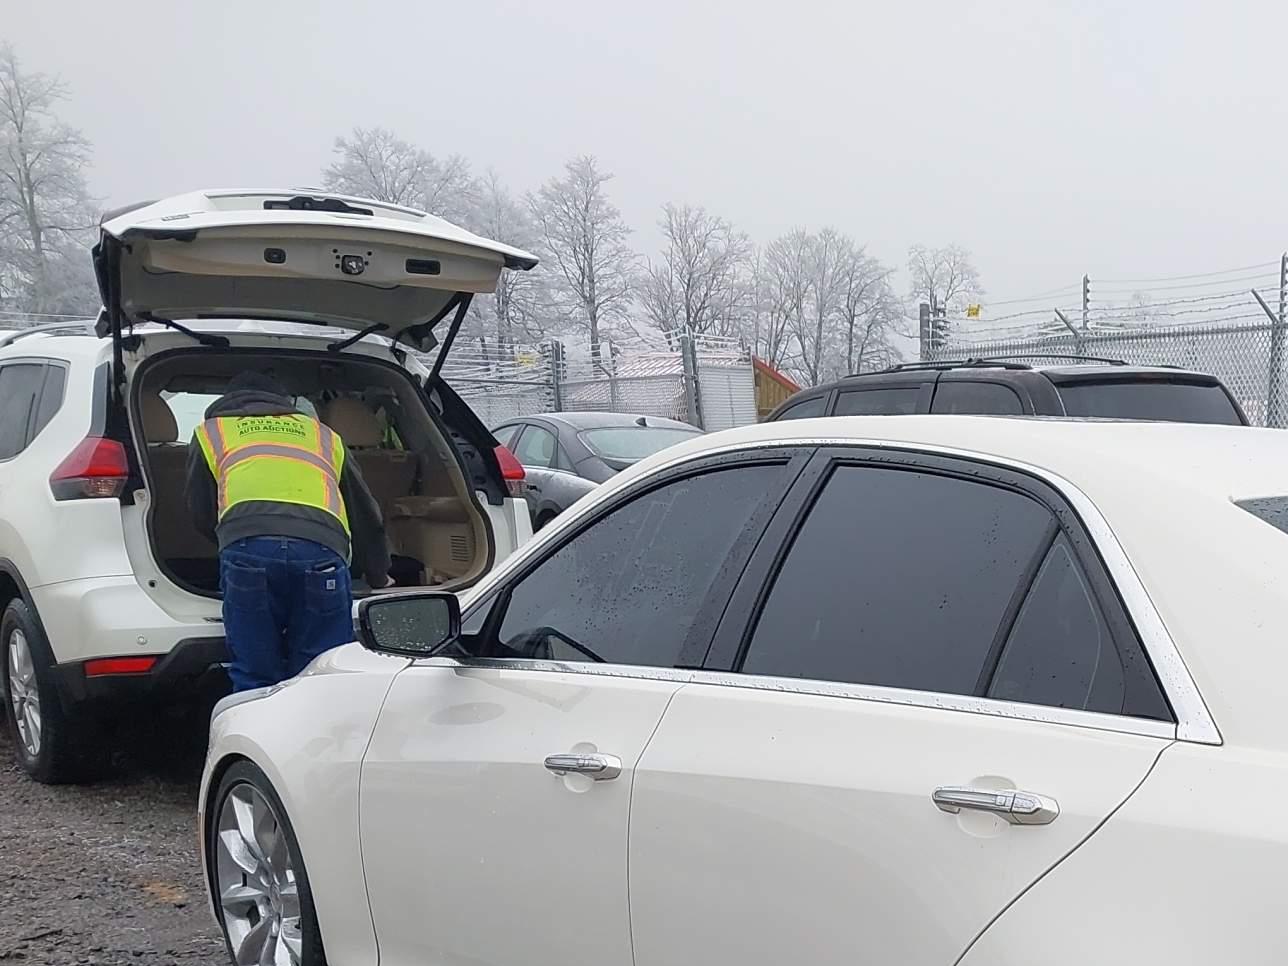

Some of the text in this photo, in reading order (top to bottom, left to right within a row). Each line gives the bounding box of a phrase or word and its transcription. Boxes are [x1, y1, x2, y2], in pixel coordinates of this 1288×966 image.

[236, 418, 305, 430] INSURANCE
[239, 424, 307, 437] AUTO AUCTIONS
